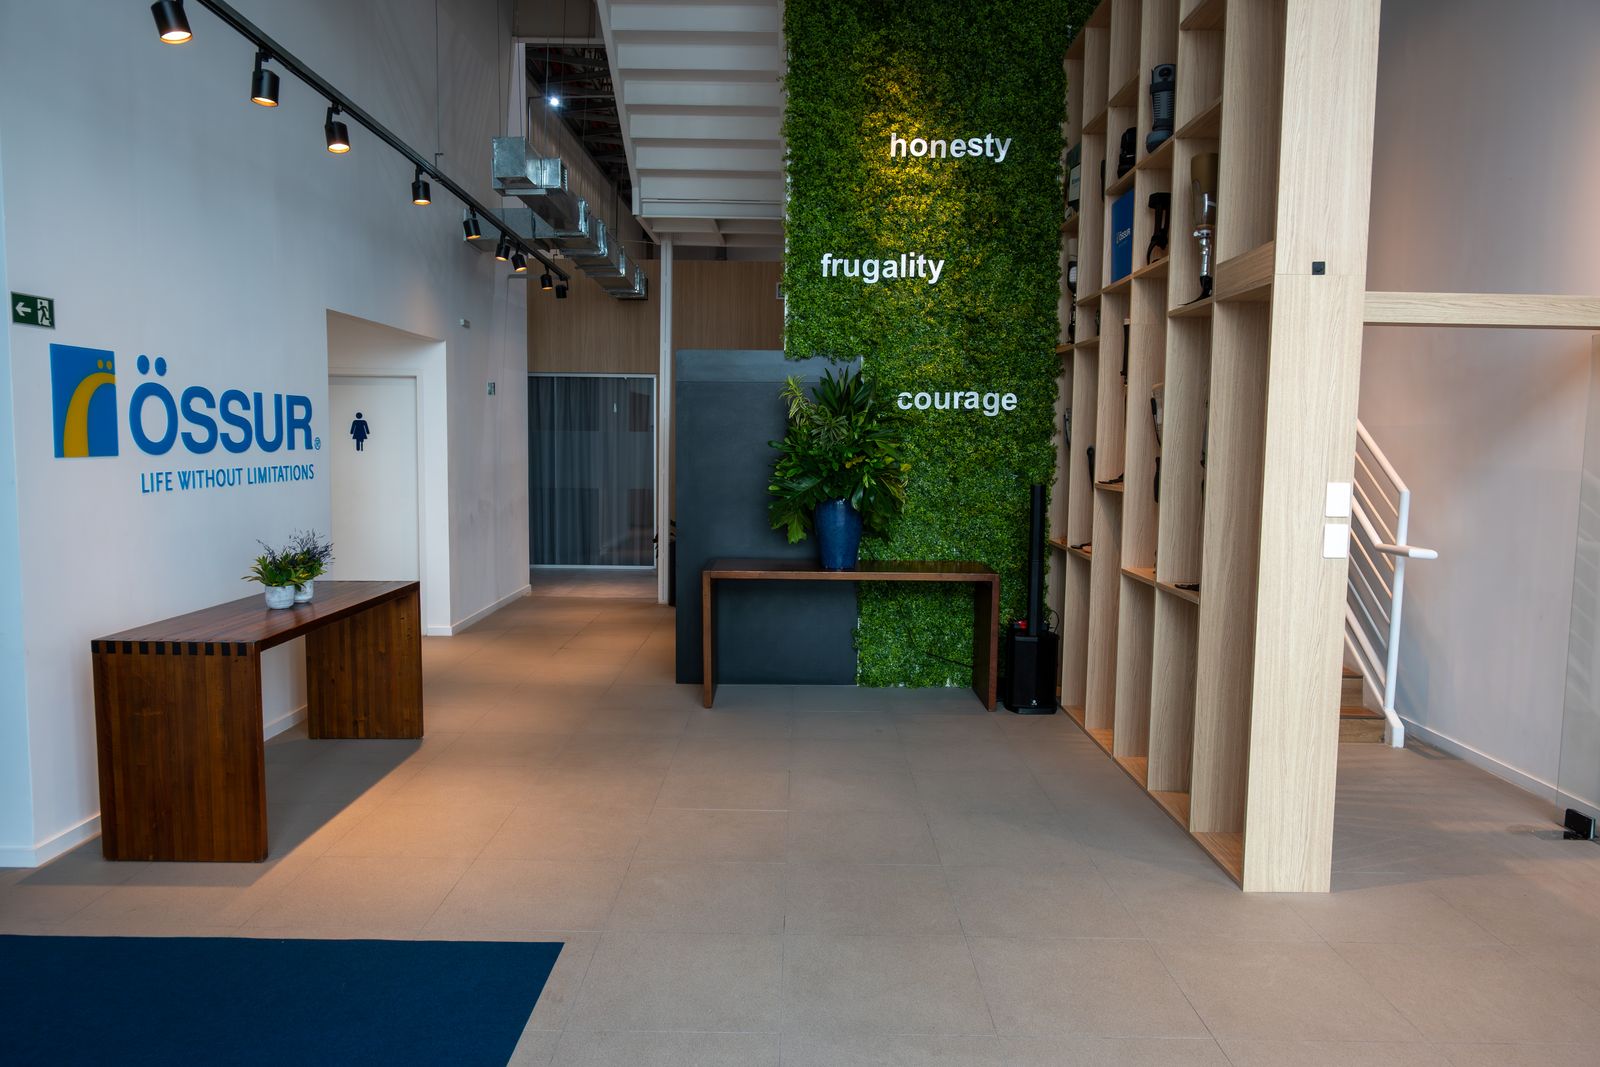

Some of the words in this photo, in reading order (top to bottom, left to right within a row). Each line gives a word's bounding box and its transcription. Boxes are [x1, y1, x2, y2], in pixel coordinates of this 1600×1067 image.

[889, 132, 1011, 163] honesty
[821, 252, 945, 284] frugality
[897, 391, 1017, 417] courage
[141, 471, 173, 493] LIFE
[177, 467, 243, 490] WITHOUT
[247, 463, 315, 485] LIMITATIONS
